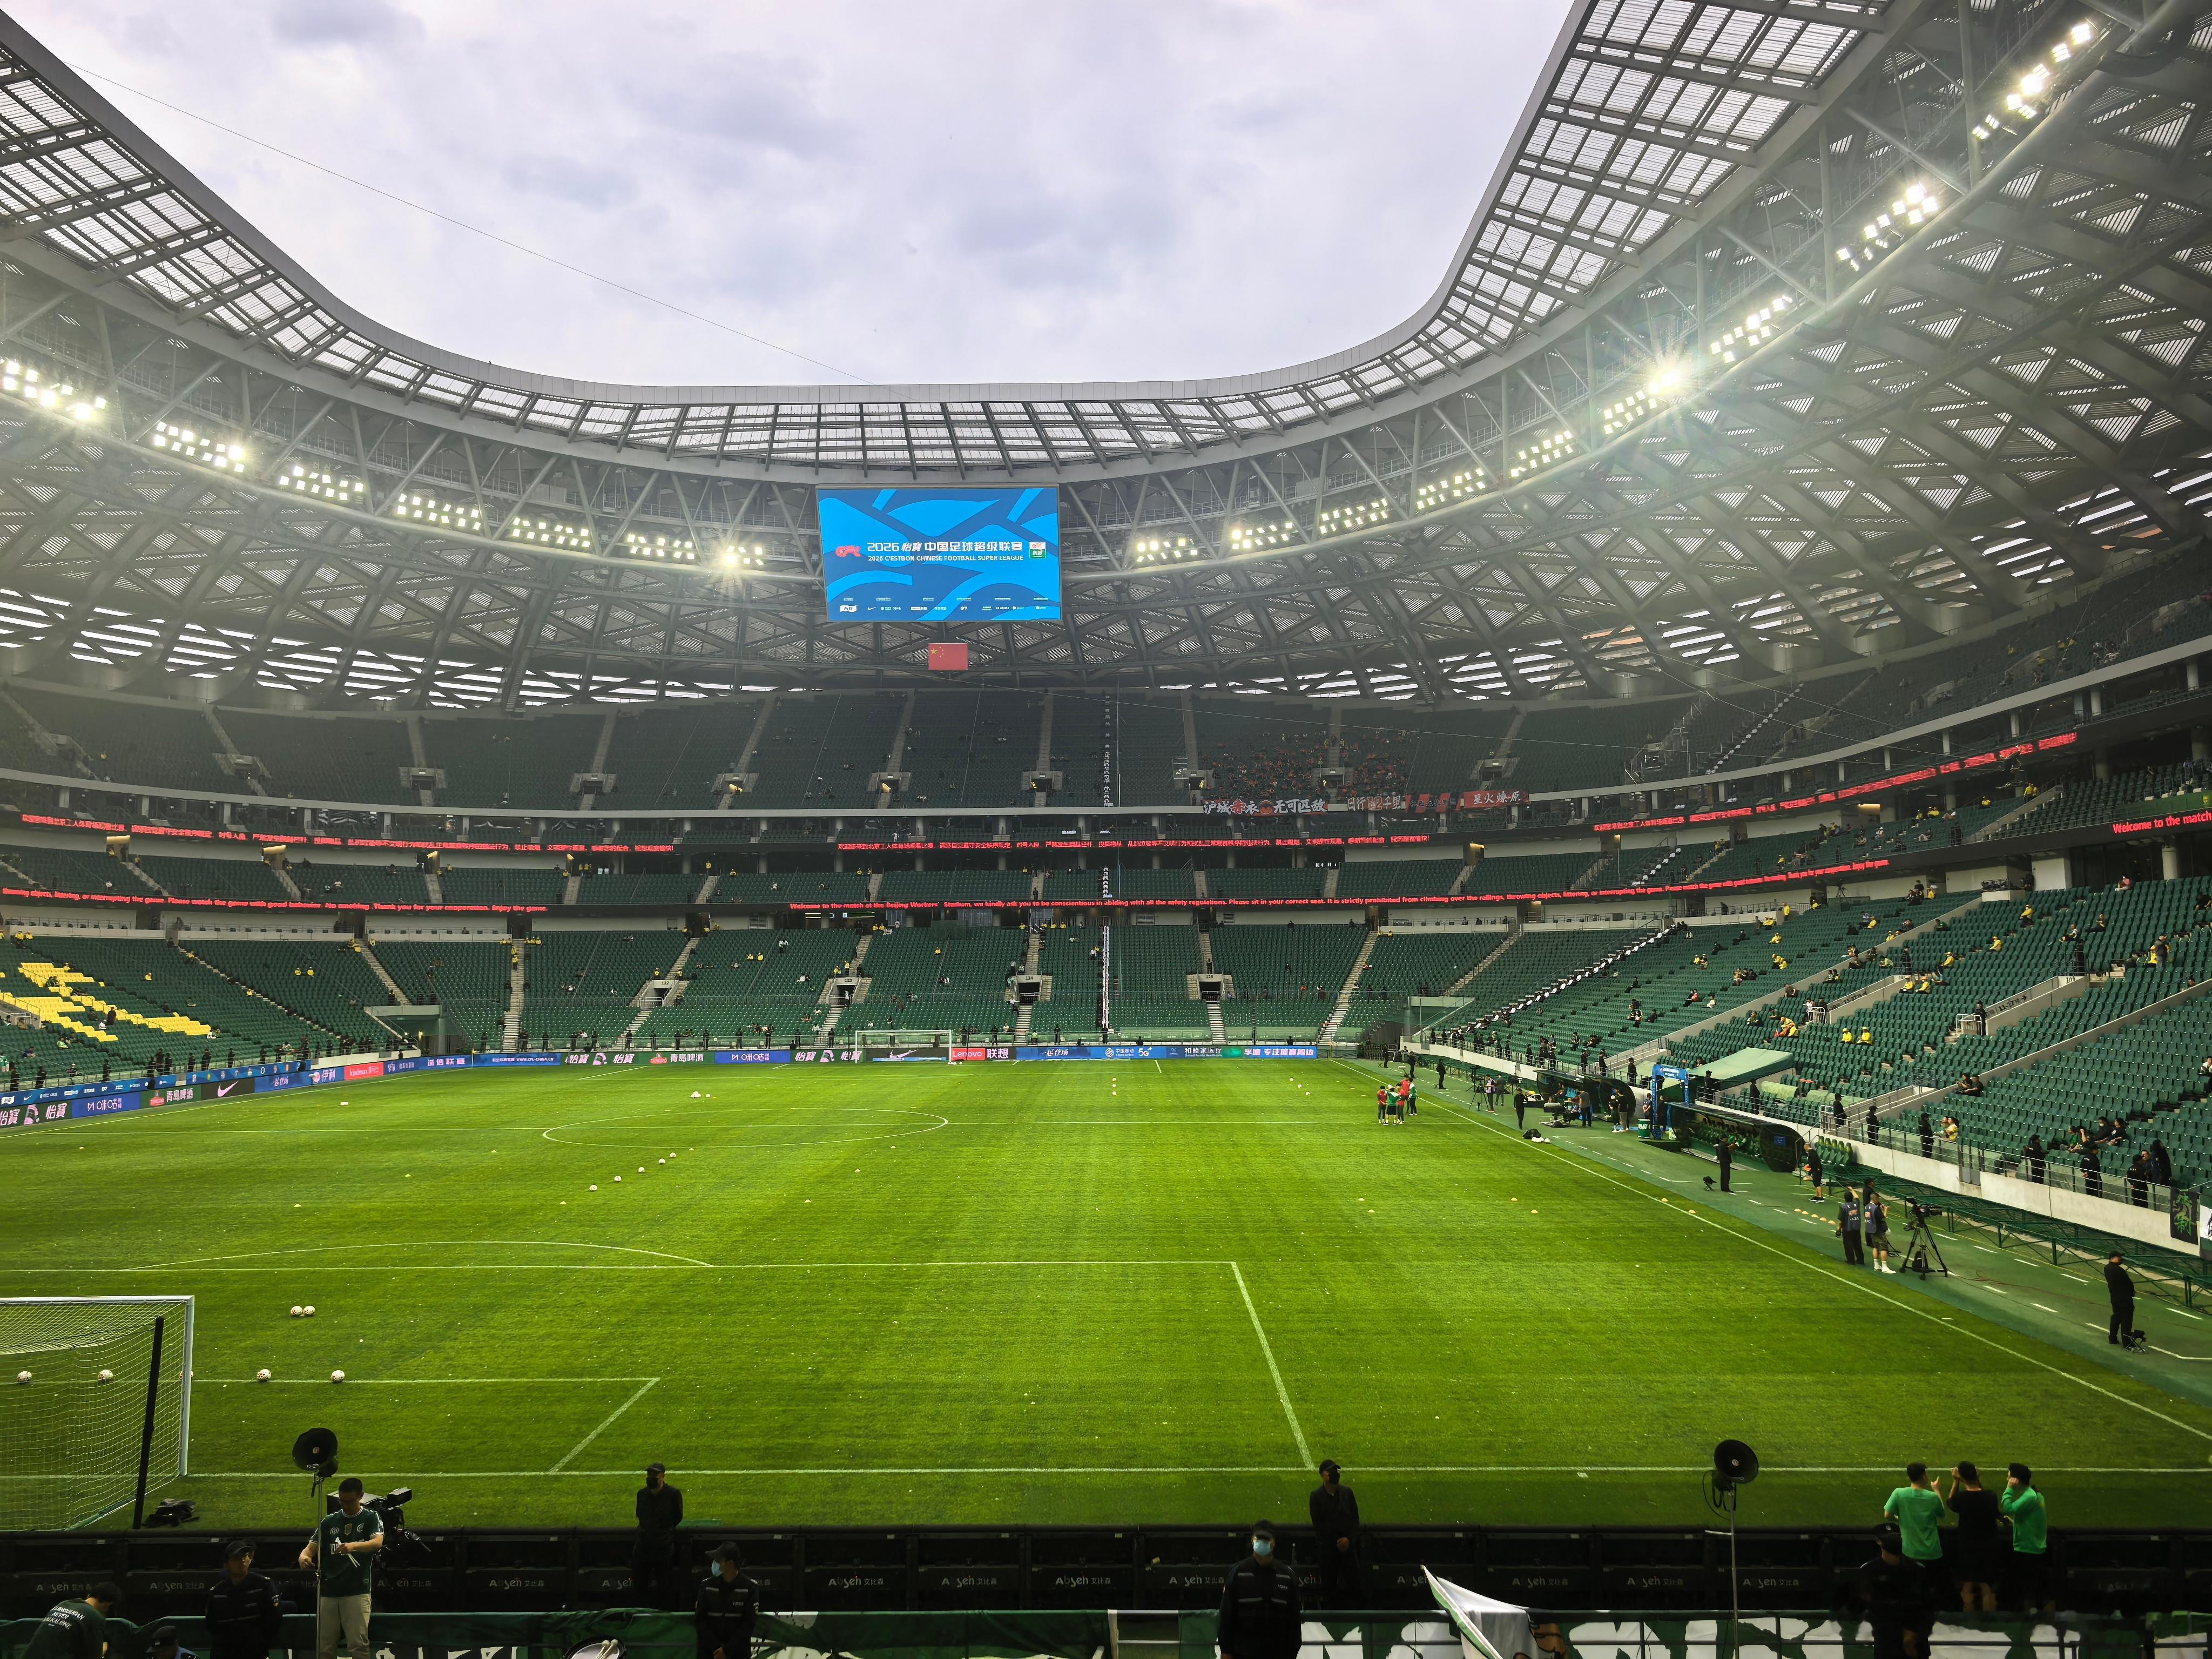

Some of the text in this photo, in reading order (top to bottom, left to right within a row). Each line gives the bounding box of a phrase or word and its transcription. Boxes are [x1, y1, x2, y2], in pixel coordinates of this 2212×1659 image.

[867, 543, 899, 551] 2026
[925, 542, 1023, 551] 中国足球超级联赛
[1273, 798, 1326, 813] 无可匹敌
[2113, 811, 2212, 834] Welcome to the match
[670, 1054, 704, 1062] 青岛啤酒
[988, 1048, 1011, 1059] 联想
[322, 1069, 336, 1082] 伊利
[166, 1088, 193, 1102] 青岛啤酒
[36, 1582, 69, 1593] Asen
[828, 1577, 861, 1588] Absen
[941, 1577, 974, 1587] Asen
[1056, 1577, 1088, 1587] Absen
[1169, 1577, 1202, 1587] Asen
[1512, 1578, 1545, 1588] Asen
[1627, 1577, 1660, 1588] Asen
[1743, 1578, 1776, 1588] Asen
